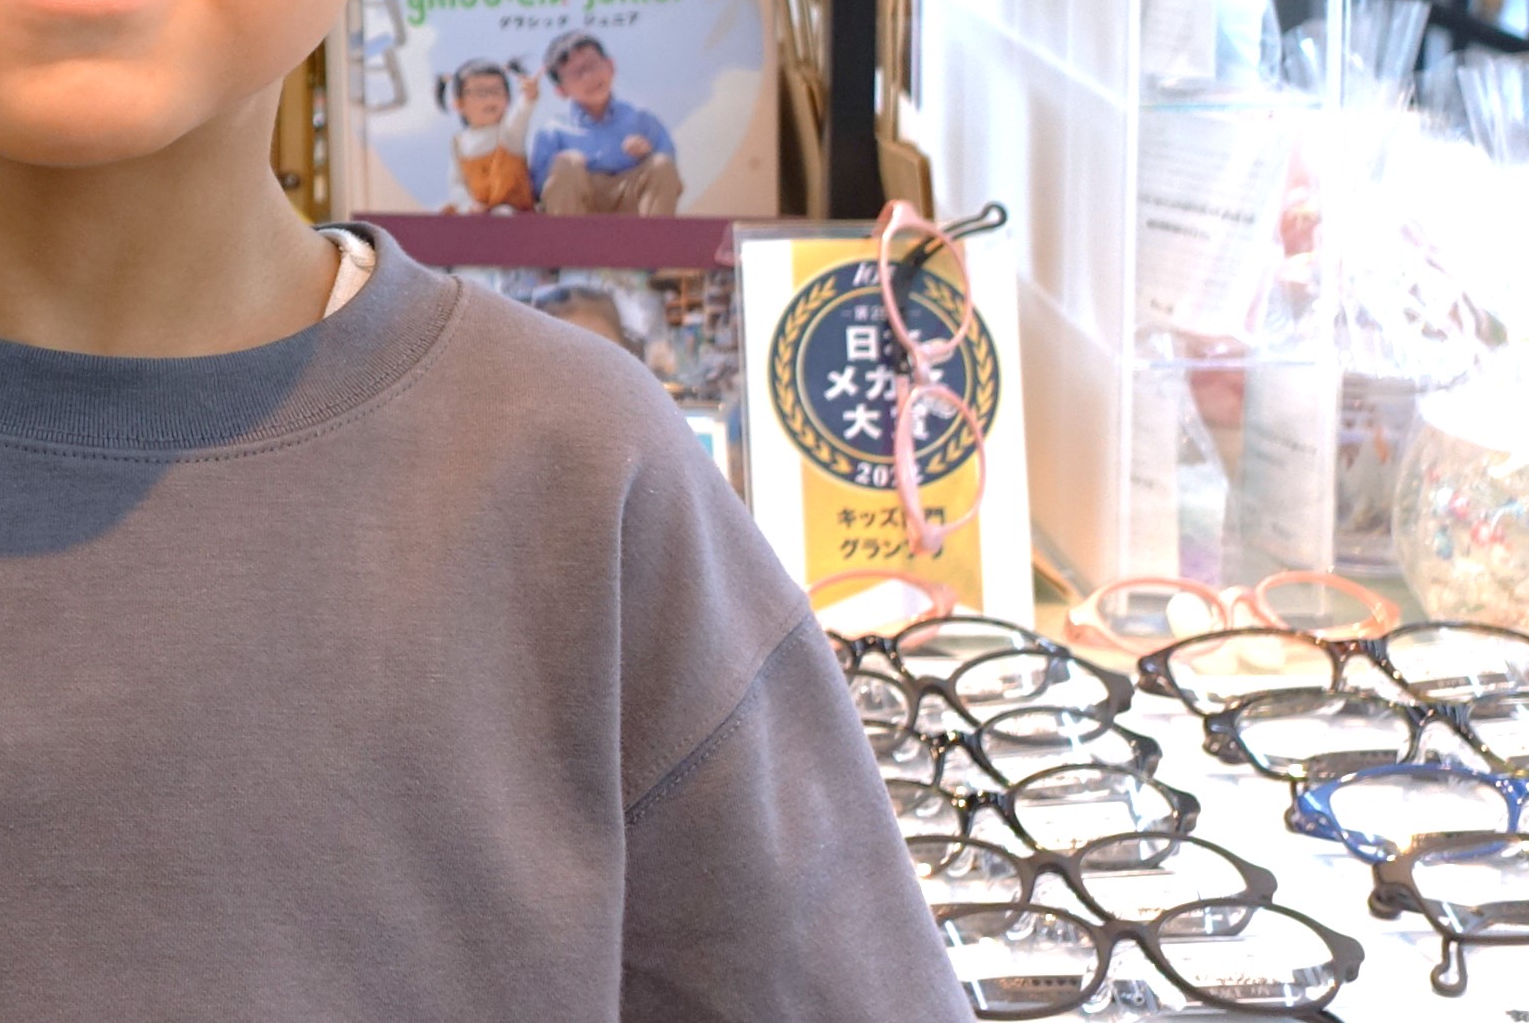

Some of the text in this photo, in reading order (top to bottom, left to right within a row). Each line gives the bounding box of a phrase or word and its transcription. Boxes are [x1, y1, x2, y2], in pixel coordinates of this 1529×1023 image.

[837, 506, 946, 530] キッズ門
[839, 537, 943, 560] グラン
